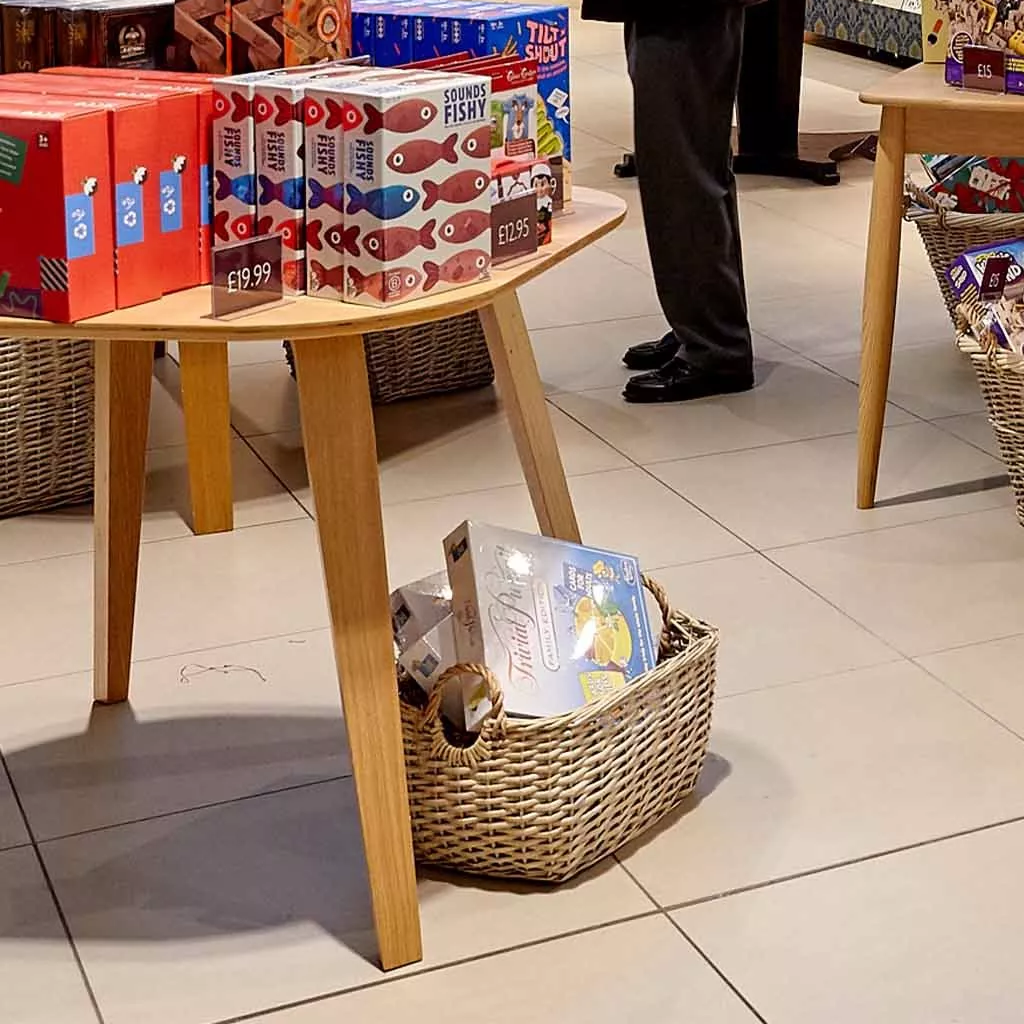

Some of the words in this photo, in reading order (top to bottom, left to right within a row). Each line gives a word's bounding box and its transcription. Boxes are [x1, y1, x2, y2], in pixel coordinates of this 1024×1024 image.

[525, 36, 567, 64] SHOUT
[977, 63, 992, 79] £15
[444, 83, 487, 105] SOUNDS
[444, 98, 487, 125] FISHY
[224, 127, 235, 168] FISHY
[267, 130, 278, 172] FISHY
[316, 134, 328, 176] FISHY
[328, 135, 336, 177] SOUNDS
[355, 138, 366, 182] FISHY
[366, 140, 374, 182] SOUNDS
[498, 217, 530, 245] £12.95
[227, 261, 272, 294] £19.99
[576, 574, 585, 589] FOR
[500, 612, 540, 691] Trivial
